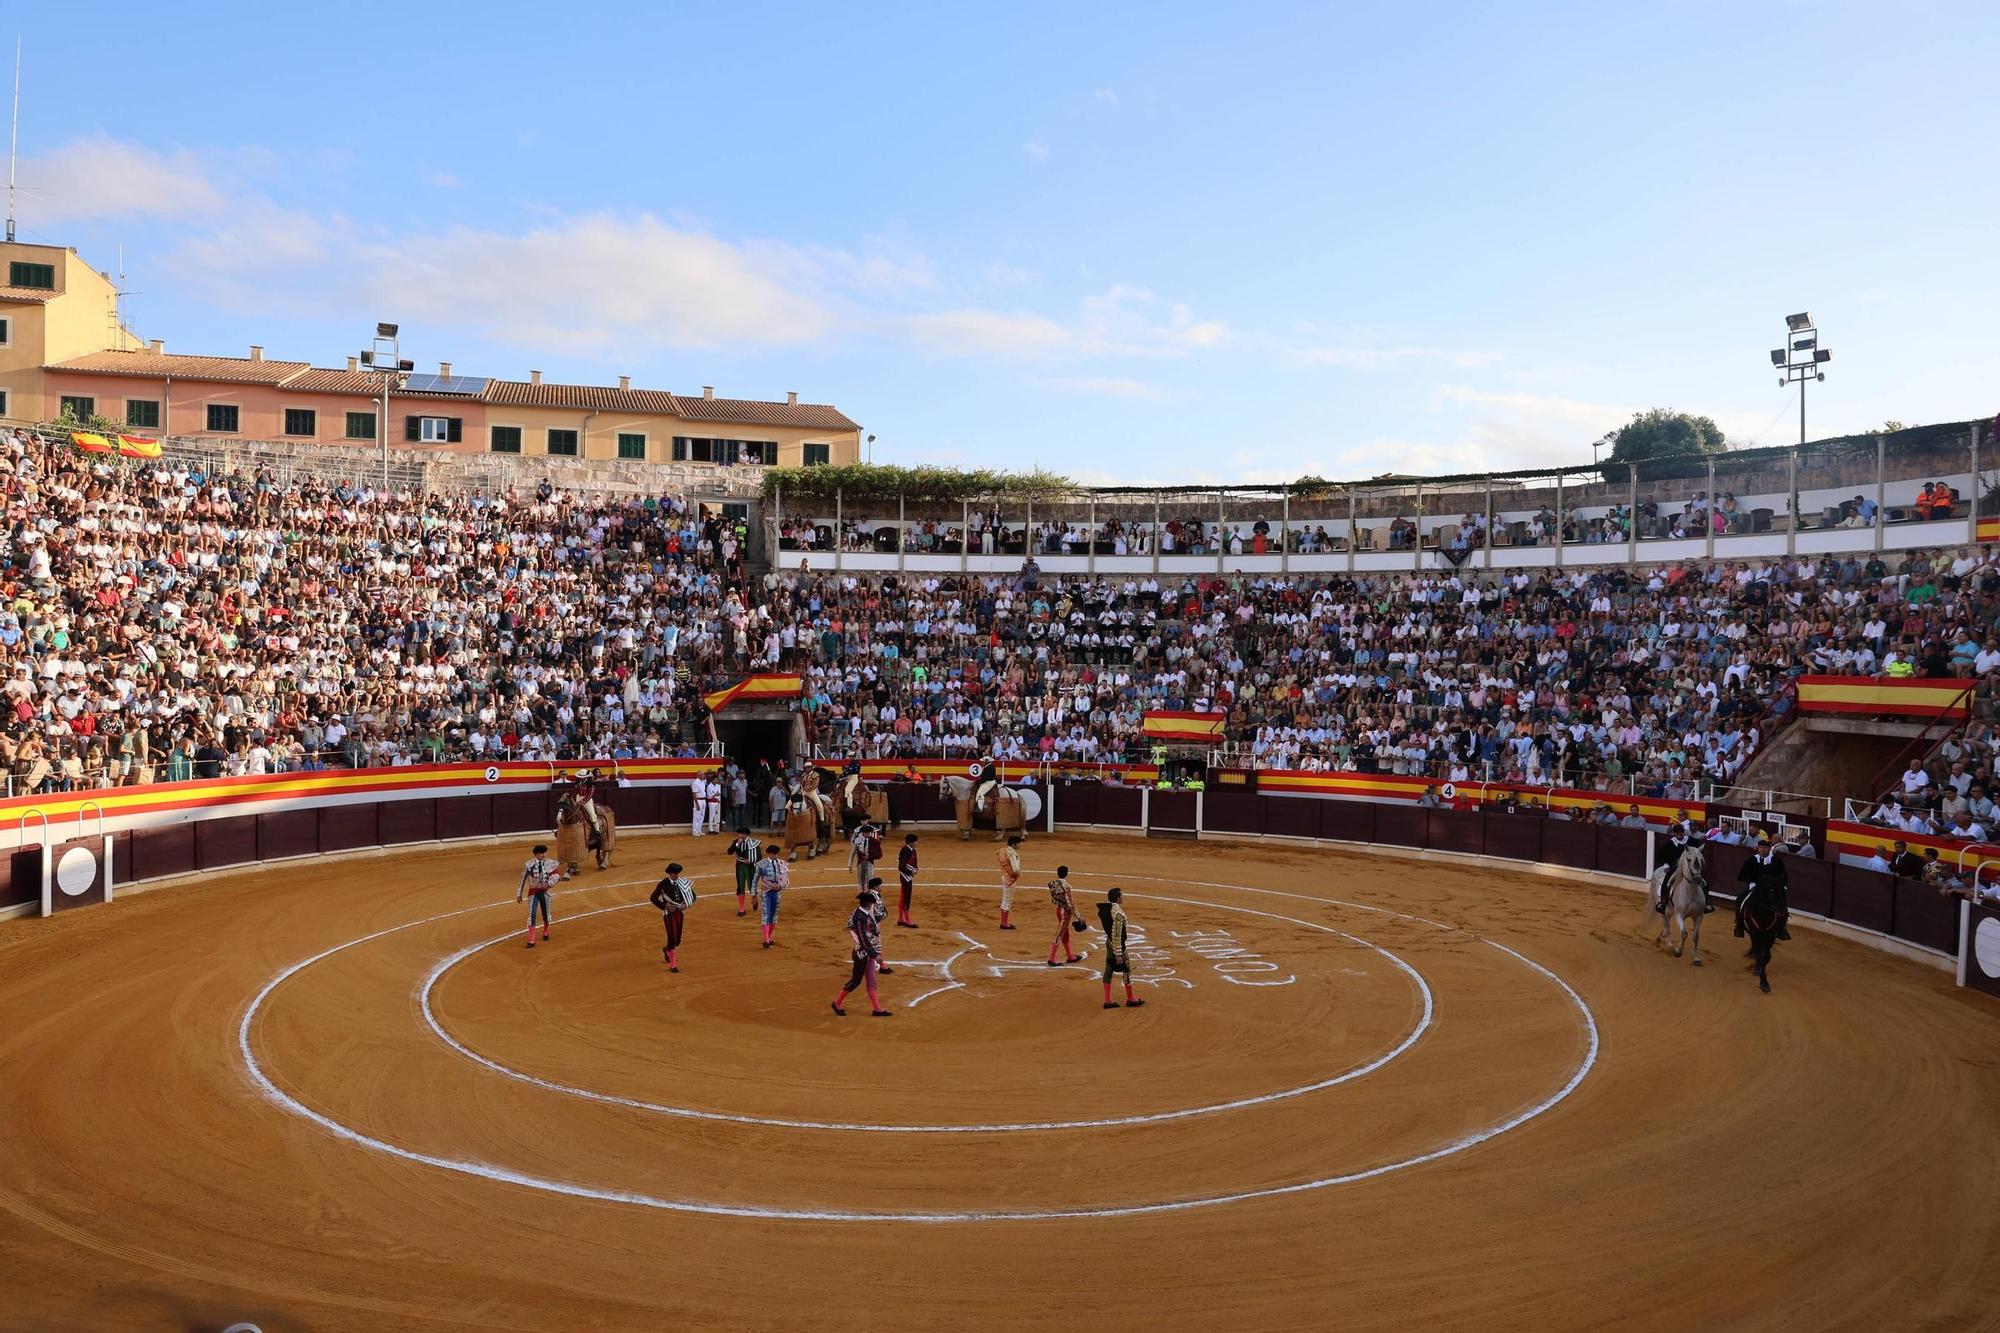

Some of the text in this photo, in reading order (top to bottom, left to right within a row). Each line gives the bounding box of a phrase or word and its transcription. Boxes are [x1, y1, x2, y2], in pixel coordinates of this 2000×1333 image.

[488, 768, 496, 780] 2
[972, 765, 979, 775] 3
[1444, 785, 1452, 796] 4
[1169, 929, 1296, 987] CONDE
